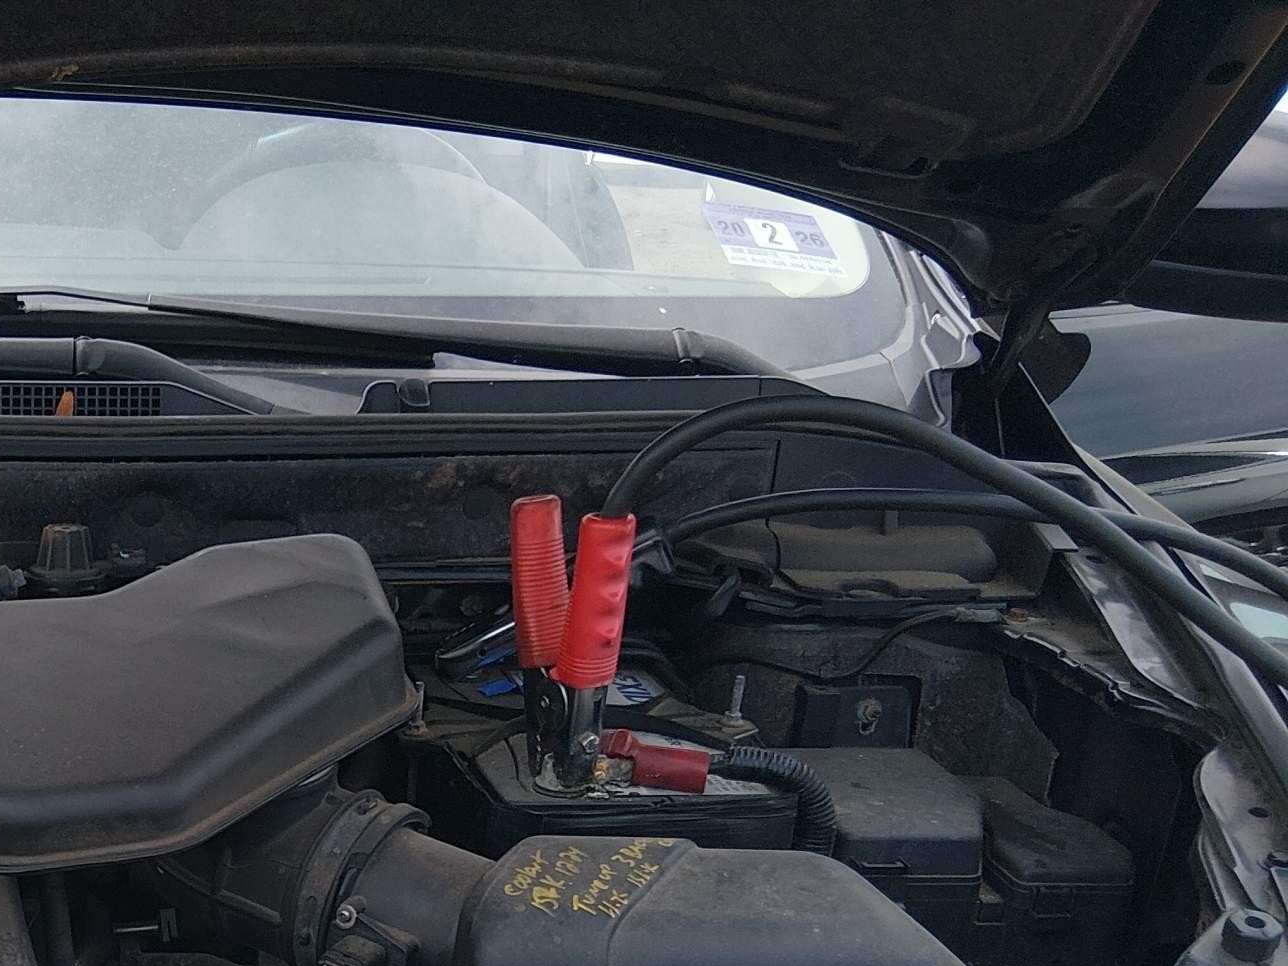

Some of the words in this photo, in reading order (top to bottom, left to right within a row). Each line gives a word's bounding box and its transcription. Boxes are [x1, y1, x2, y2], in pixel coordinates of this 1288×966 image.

[717, 220, 745, 237] 20
[761, 222, 783, 246] 2
[795, 231, 825, 247] 26
